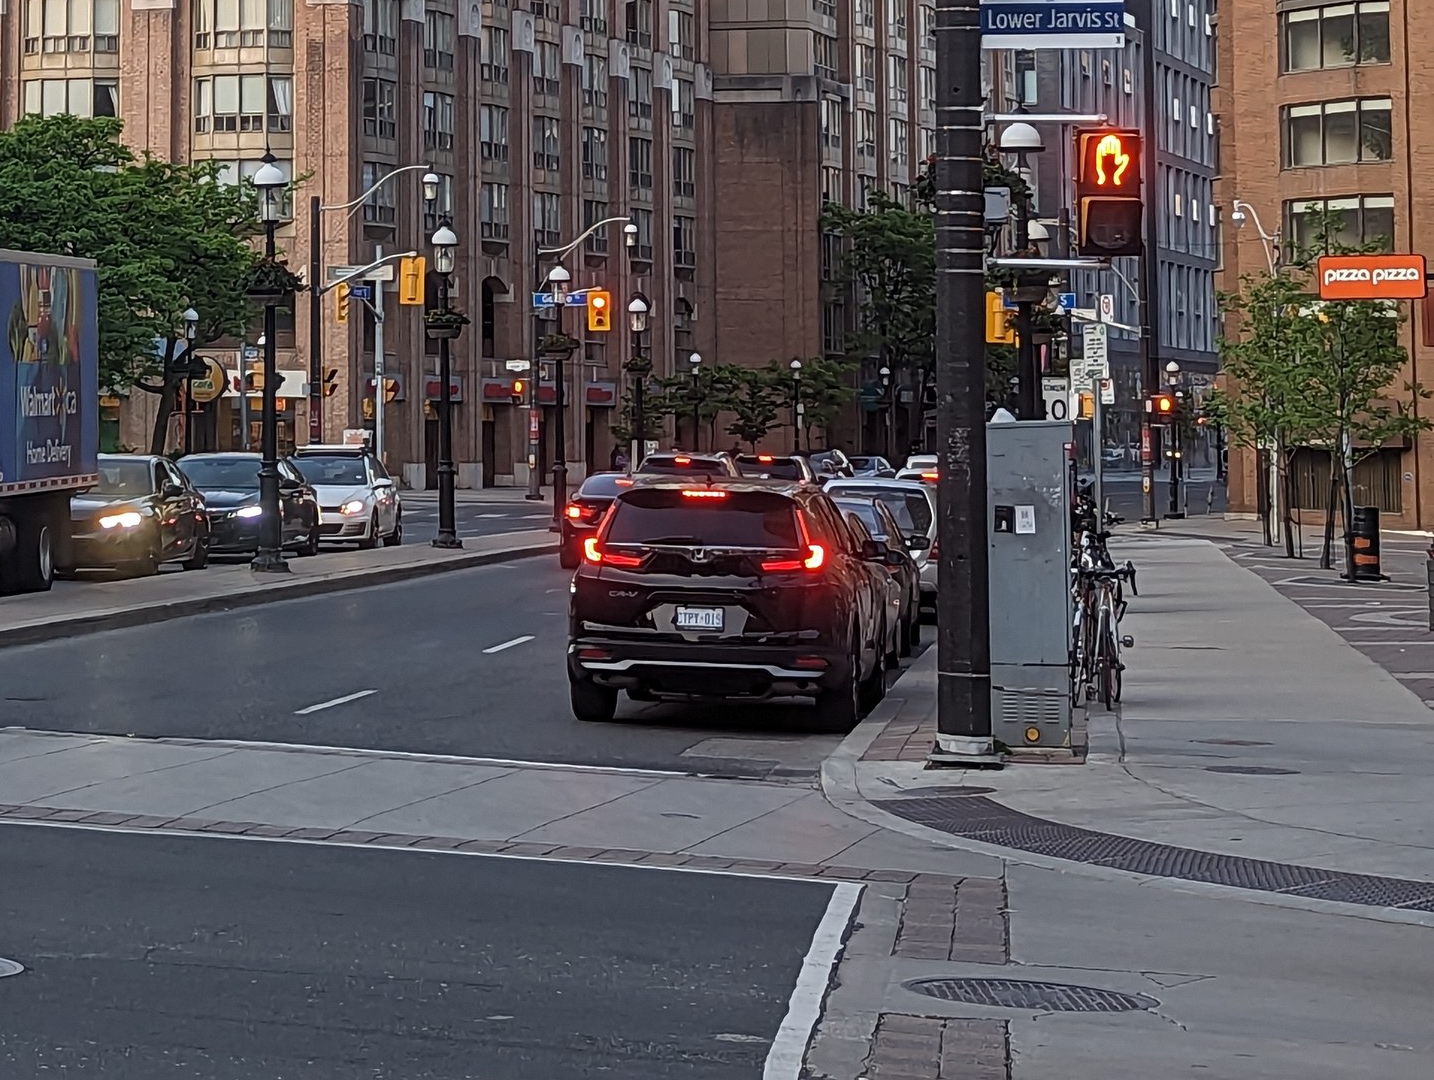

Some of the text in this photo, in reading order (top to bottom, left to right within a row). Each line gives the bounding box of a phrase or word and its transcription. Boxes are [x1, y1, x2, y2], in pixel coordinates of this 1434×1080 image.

[987, 7, 1119, 29] Lower Jarvis St
[1324, 267, 1419, 286] pizza pizza
[20, 386, 56, 416] Walmart
[26, 438, 72, 468] Home Delivery
